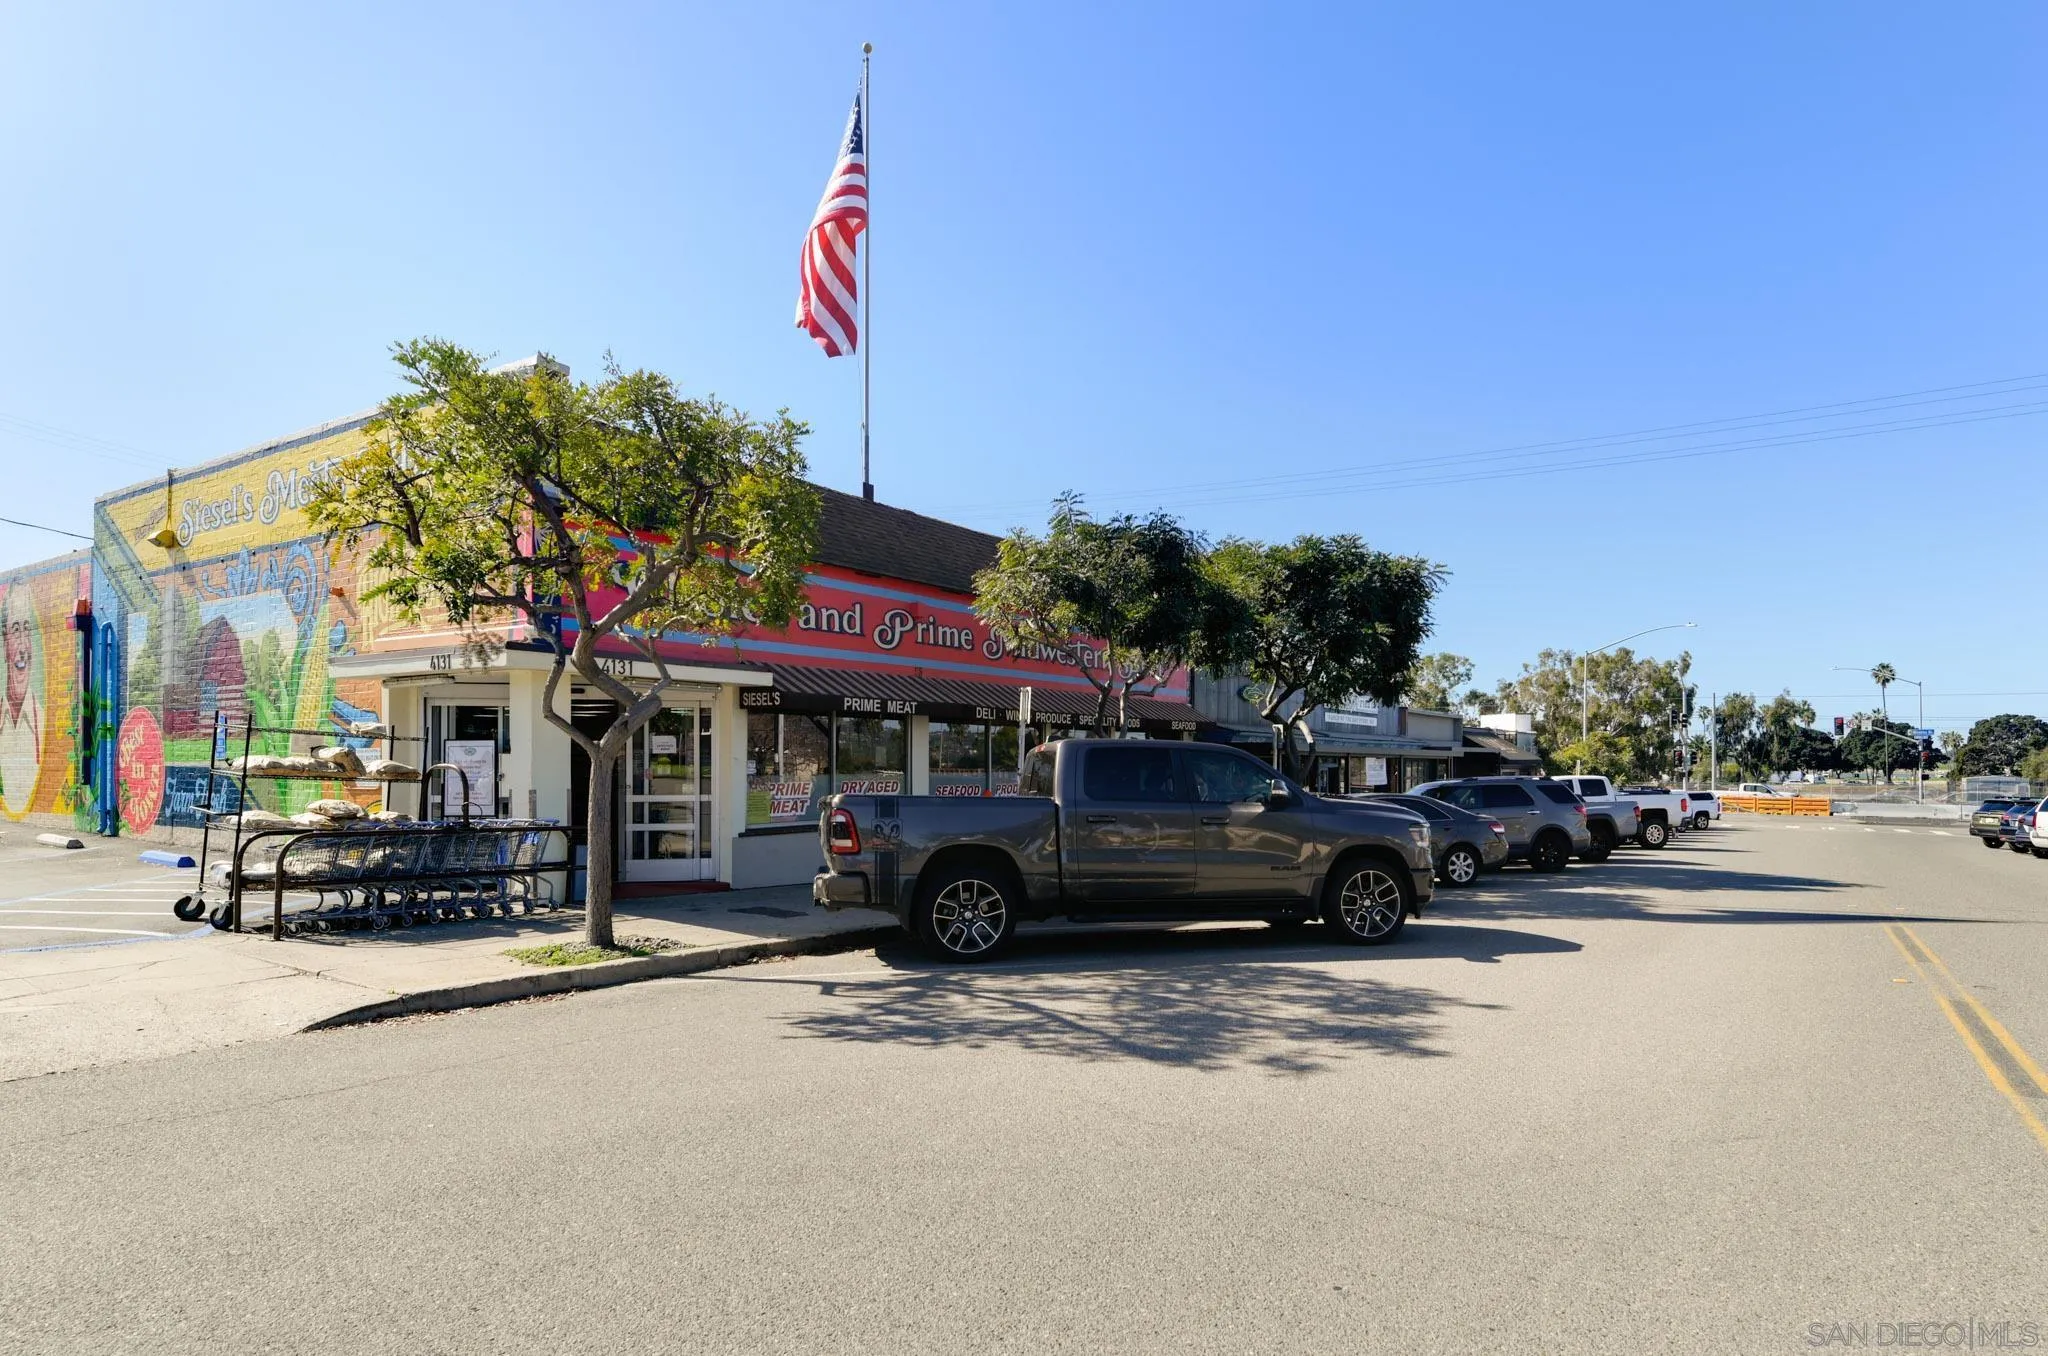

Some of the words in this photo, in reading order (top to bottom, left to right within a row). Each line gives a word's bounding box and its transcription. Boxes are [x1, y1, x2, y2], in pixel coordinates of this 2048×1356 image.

[177, 485, 254, 547] Siesel's
[259, 456, 350, 524] Meat
[799, 602, 864, 635] and
[873, 609, 974, 650] Prime
[430, 655, 451, 671] 4131
[602, 659, 633, 675] 4131
[742, 692, 780, 706] SIESEL'S
[843, 697, 881, 712] PRIME
[887, 701, 917, 714] MEAT
[976, 706, 996, 720] DELI
[1005, 708, 1023, 722] WIN
[1035, 711, 1071, 724] PRODUCE
[1079, 714, 1117, 727] SPECLITY
[1171, 720, 1196, 731] SEAFOOD
[769, 781, 811, 796] PRIME
[840, 781, 865, 794] DRY
[866, 780, 899, 793] AGED
[935, 785, 981, 796] SEAFOOD
[996, 784, 1018, 796] PROD
[769, 799, 808, 815] MEAT
